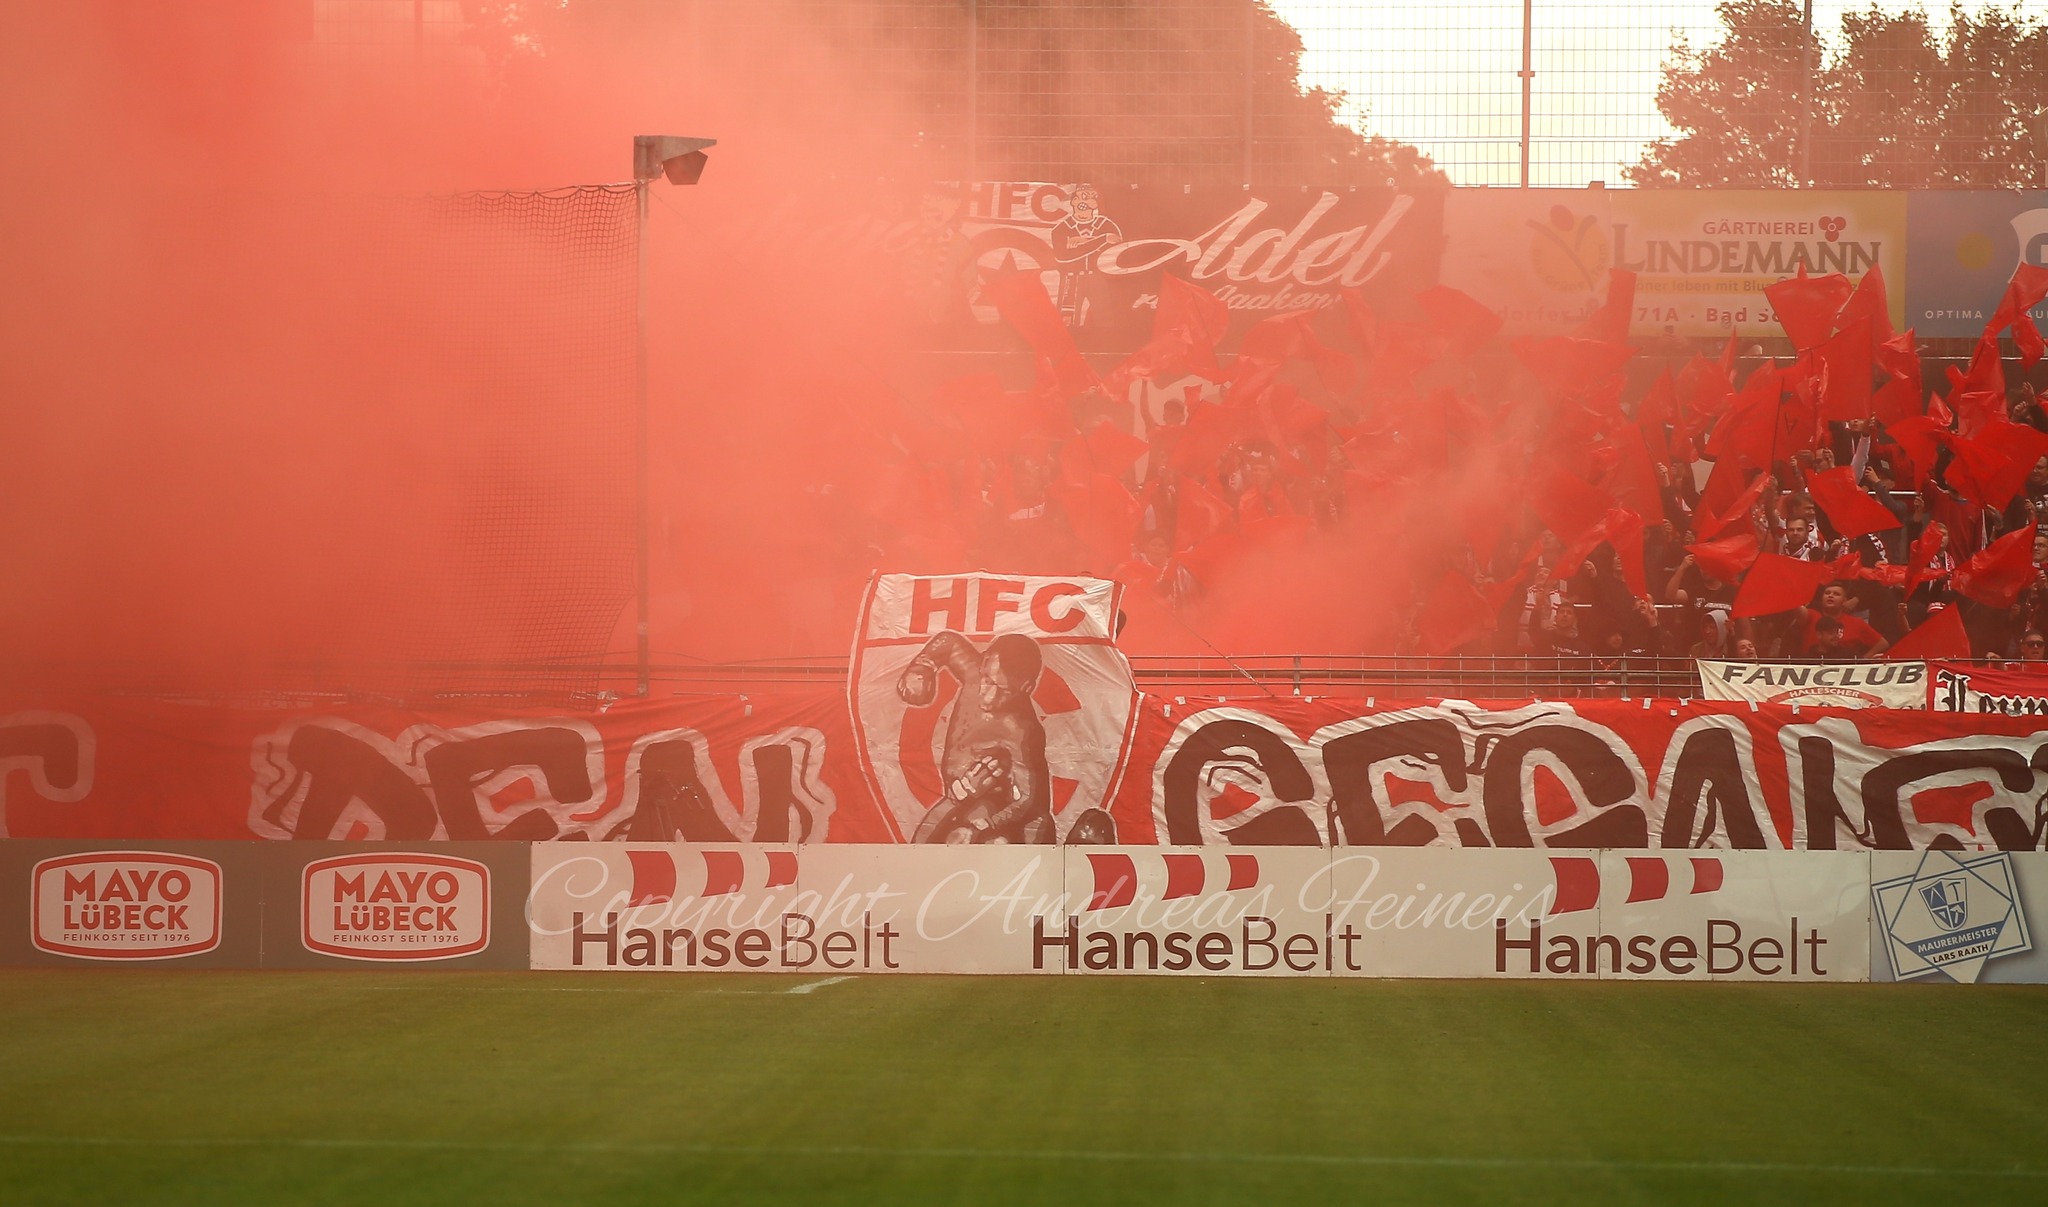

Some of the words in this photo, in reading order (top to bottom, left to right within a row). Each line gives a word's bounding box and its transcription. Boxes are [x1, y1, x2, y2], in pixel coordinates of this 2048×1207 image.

[960, 183, 1069, 221] HFC
[1703, 216, 1814, 235] GÄRTNEREI
[1097, 191, 1413, 287] Adel
[1612, 222, 1881, 275] LINDEMANN
[1673, 278, 1710, 292] leben
[1716, 278, 1738, 292] mit
[1638, 307, 1679, 322] 71A
[1706, 307, 1747, 323] Bad
[1925, 310, 1983, 319] OPTIMA
[908, 578, 1087, 633] HFC
[1721, 664, 1926, 687] FANCLUB
[1788, 687, 1861, 698] HALLESCHER
[63, 869, 192, 902] MAYO
[333, 870, 460, 903] MAYO
[63, 933, 126, 942] FEINKOST
[131, 933, 158, 942] SEIT
[163, 933, 191, 942] 1976
[333, 934, 396, 943] FEINKOST
[400, 934, 428, 943] SEIT
[432, 934, 460, 943] 1976
[572, 910, 900, 969] HanseBelt
[1032, 913, 1362, 971] HanseBelt
[1495, 916, 1828, 976] HanseBelt
[1918, 927, 1998, 953] MAURERMEISTER
[1933, 951, 1956, 964] LARS
[1958, 944, 1989, 958] RAATH
